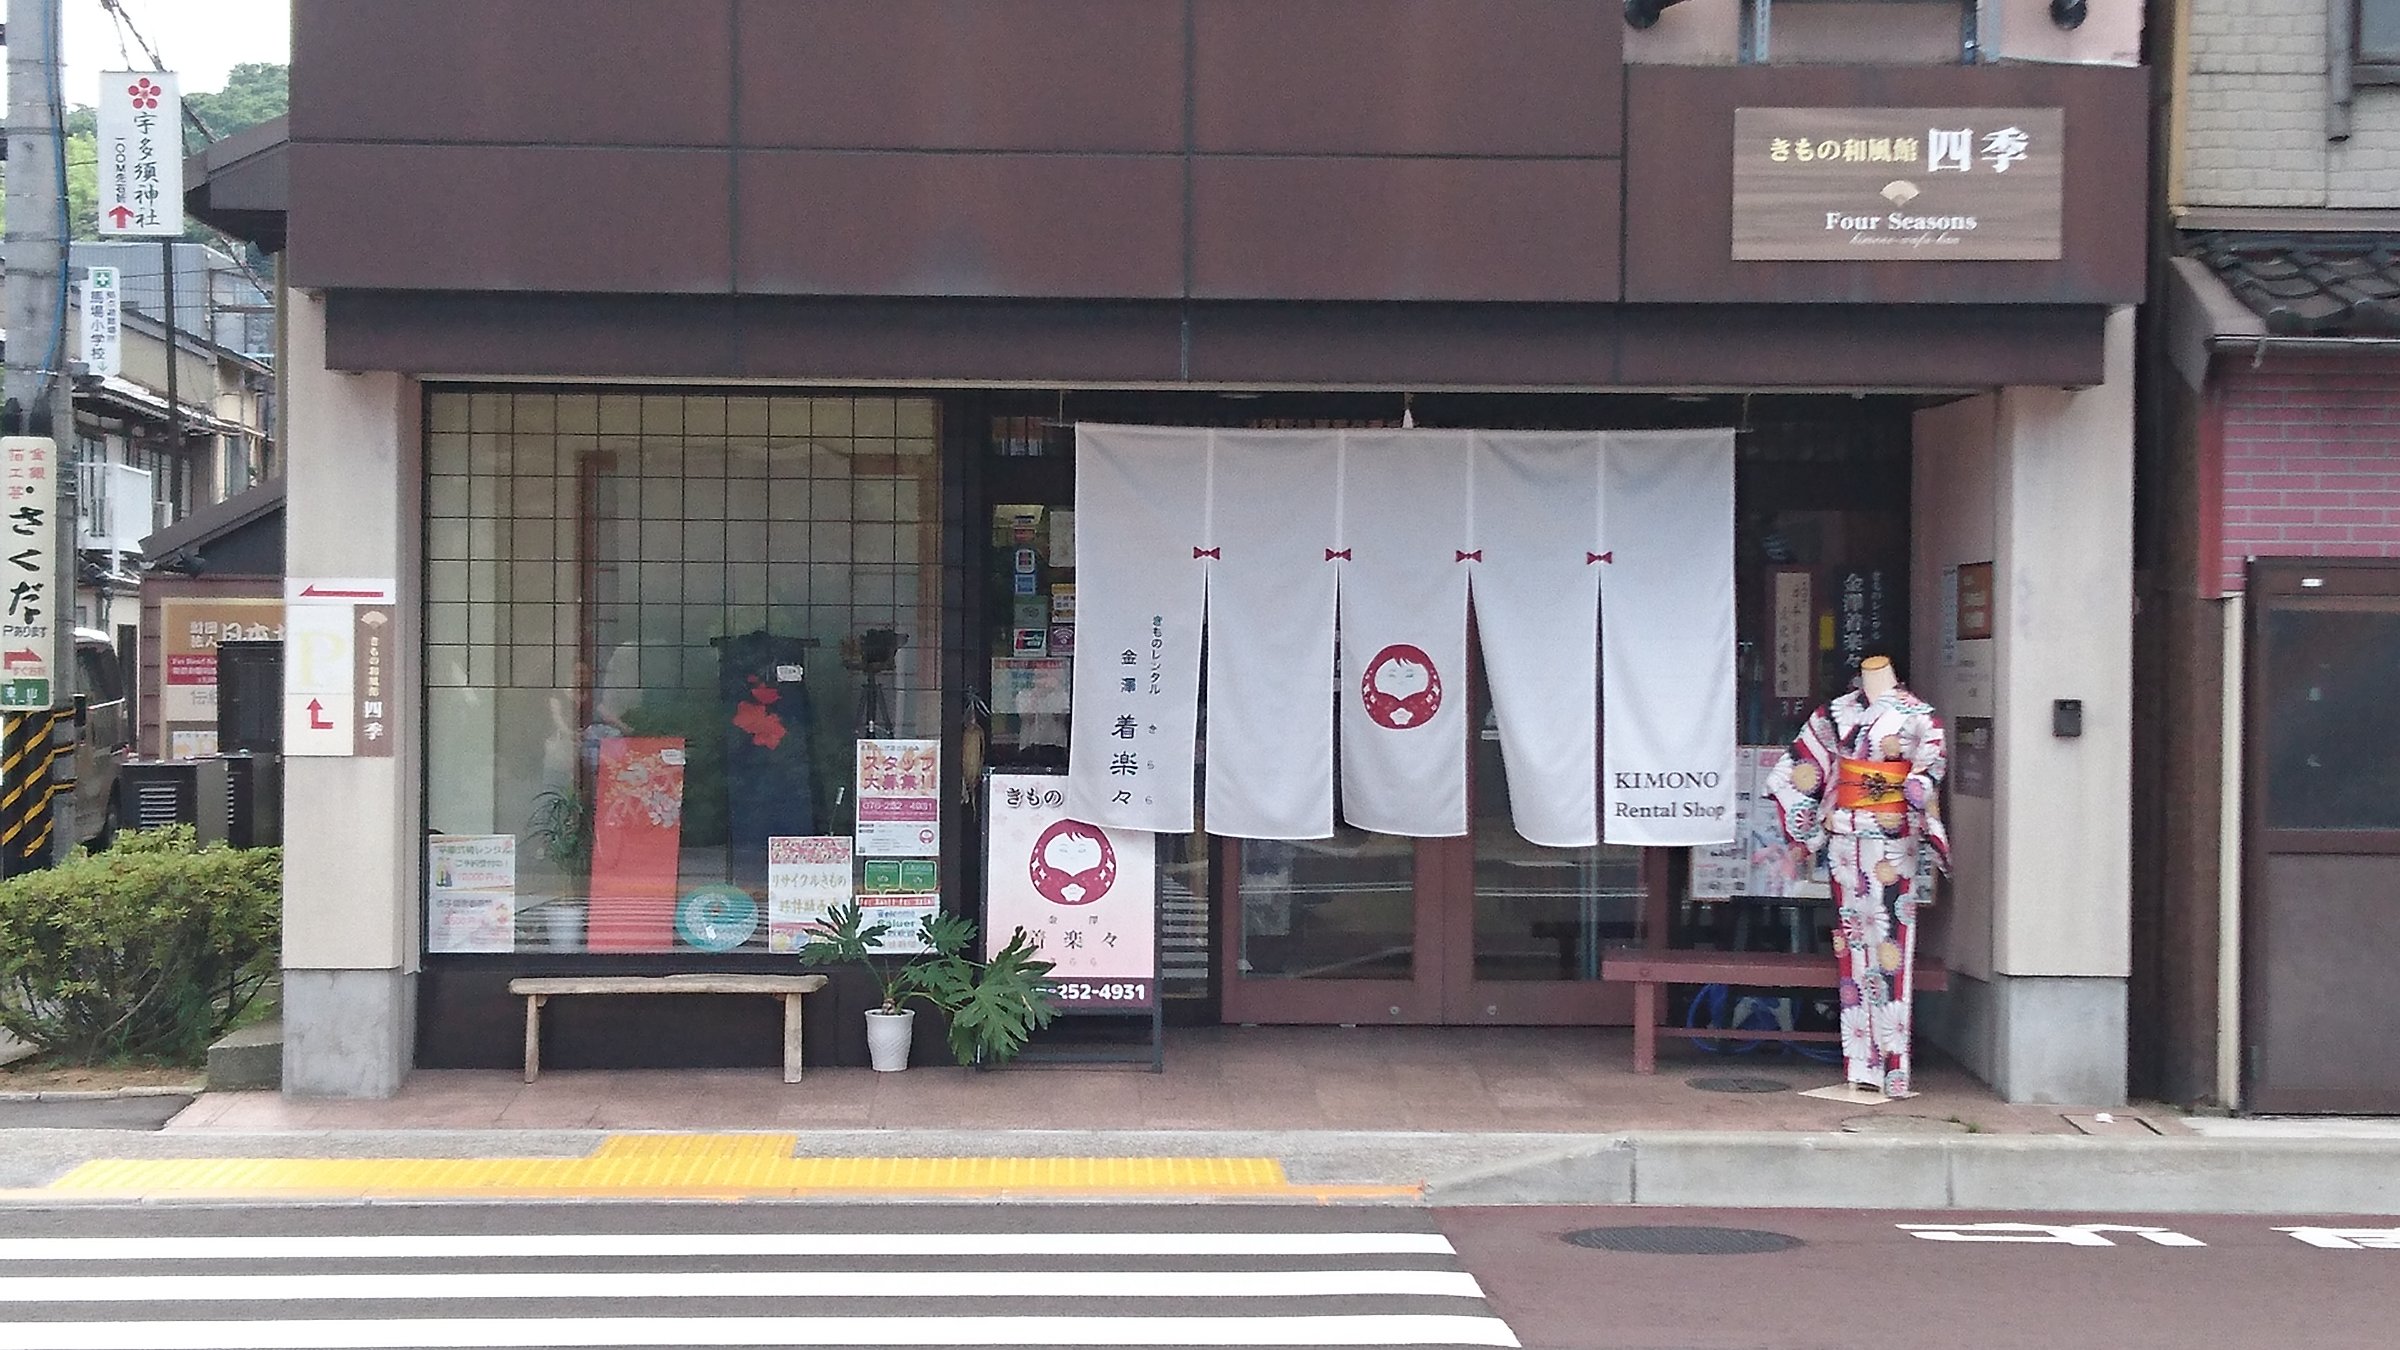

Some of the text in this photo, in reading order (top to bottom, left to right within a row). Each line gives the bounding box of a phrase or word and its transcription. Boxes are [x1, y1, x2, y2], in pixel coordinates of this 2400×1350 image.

[134, 111, 160, 229] 宇多須神社
[1770, 126, 2029, 173] きもの和風館 四季
[1825, 211, 1977, 231] Four Seasons
[8, 506, 45, 625] さくだ
[1148, 614, 1164, 695] きものレンタル
[363, 701, 384, 741] 四季
[863, 755, 936, 772] スタッフ
[1110, 713, 1139, 805] 着楽々
[1614, 771, 1719, 789] KIMONO
[1615, 802, 1725, 821] Rental Shop
